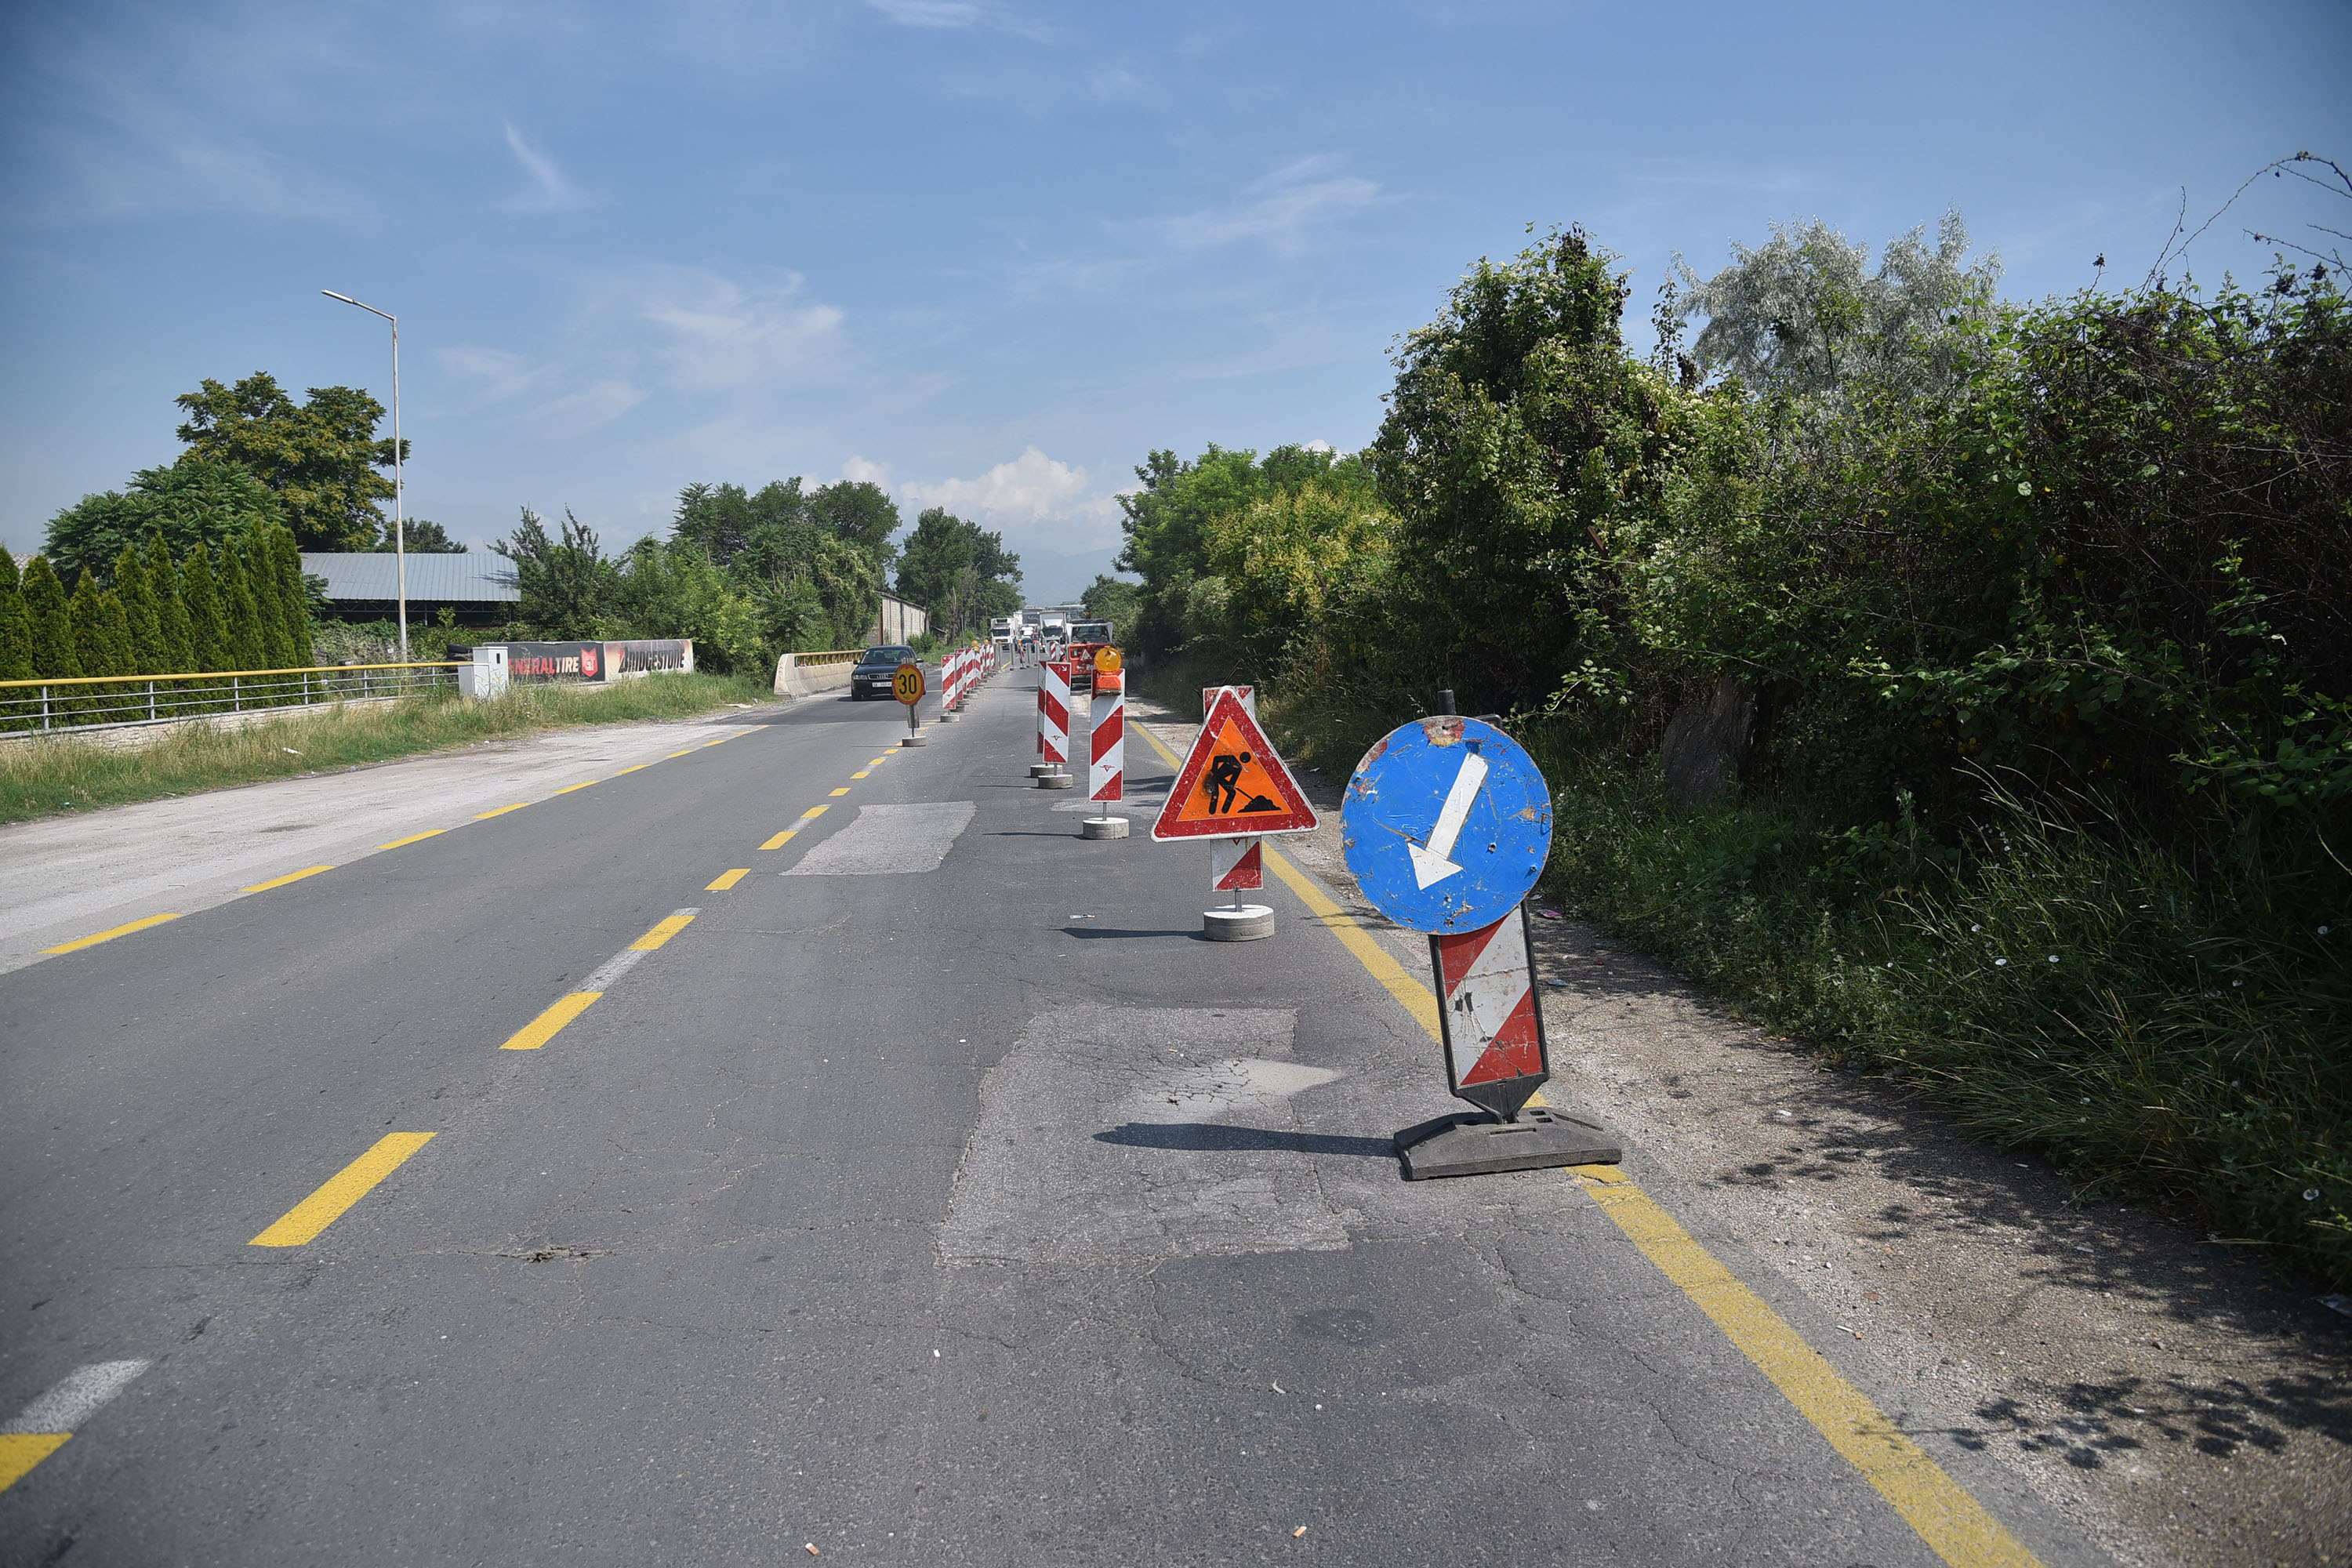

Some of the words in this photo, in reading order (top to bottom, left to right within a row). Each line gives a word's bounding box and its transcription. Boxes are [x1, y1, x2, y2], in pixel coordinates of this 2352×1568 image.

[508, 657, 555, 675] ENERAL
[618, 645, 684, 673] BRIDGESTONE
[899, 673, 917, 695] 30
